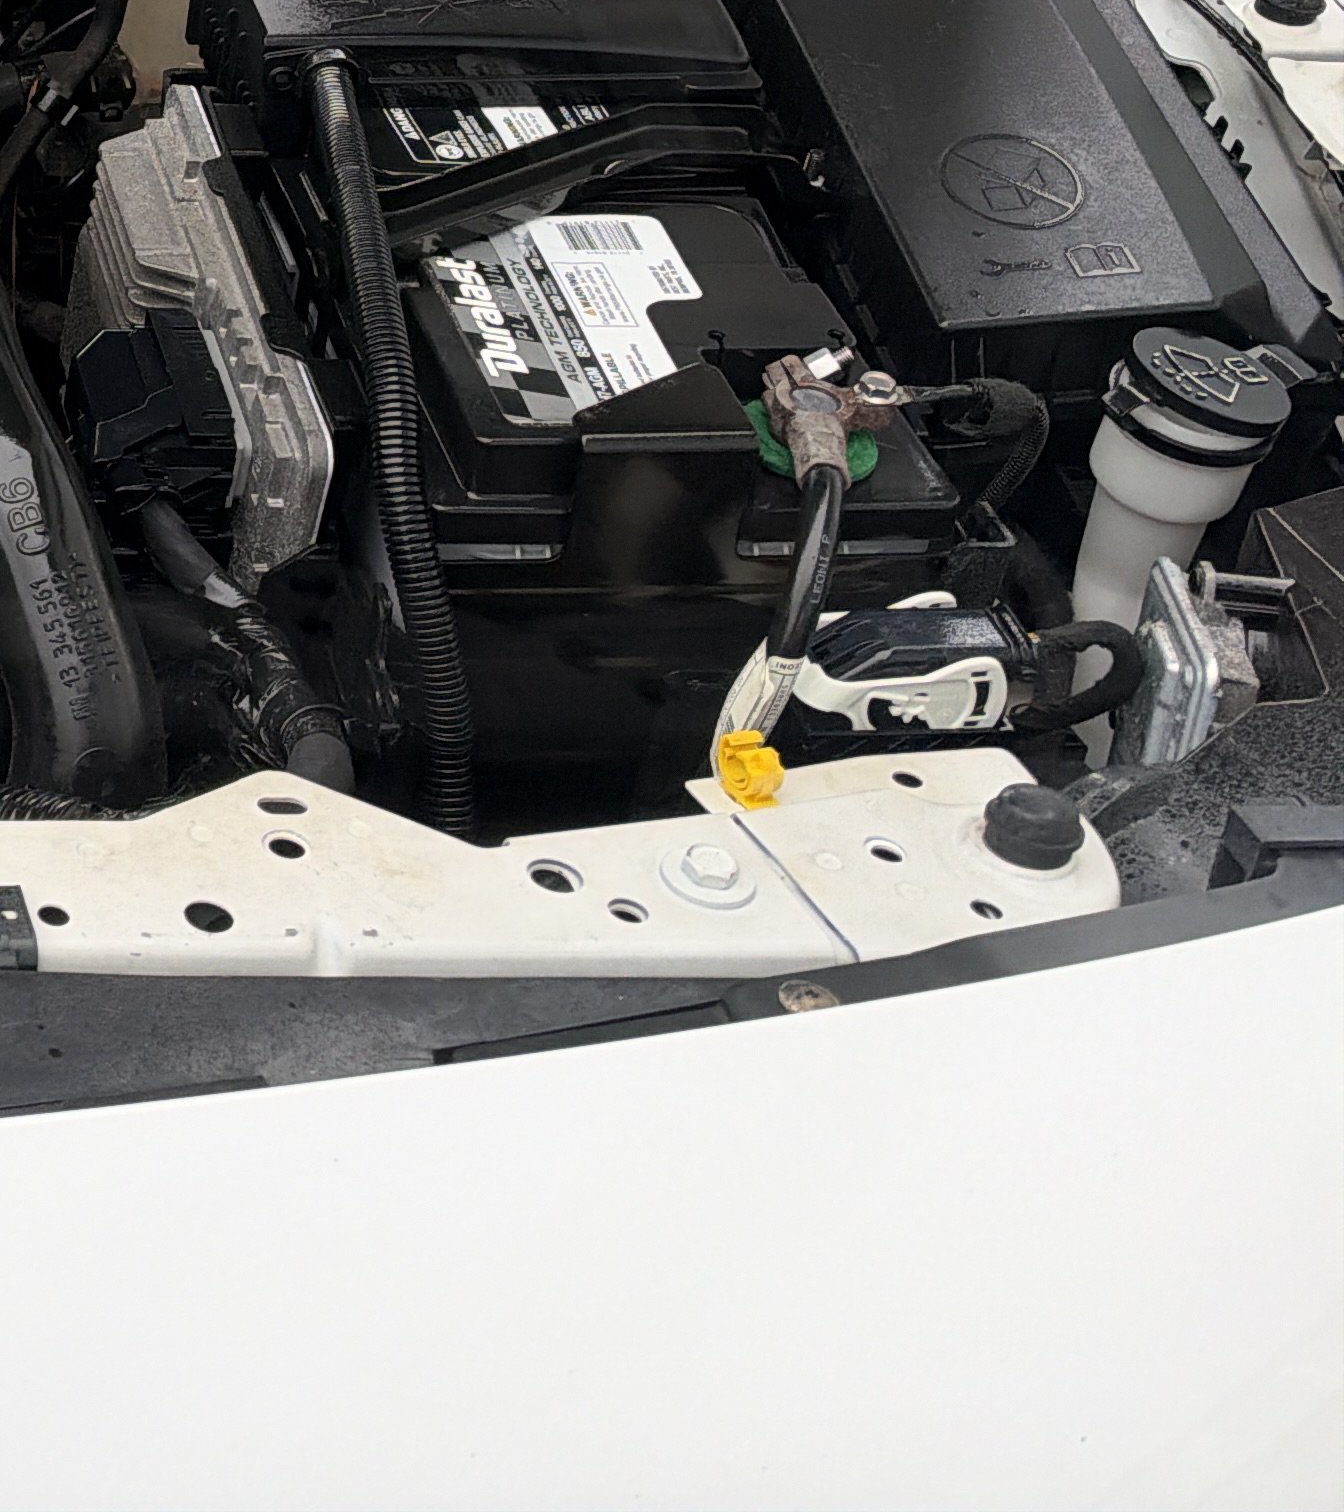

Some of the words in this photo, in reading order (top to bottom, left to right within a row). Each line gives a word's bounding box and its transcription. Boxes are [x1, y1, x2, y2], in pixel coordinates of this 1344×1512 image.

[436, 256, 529, 377] Duralast
[479, 261, 535, 342] PLATINUM
[506, 257, 563, 347] TECHNOLOGY
[554, 350, 583, 384] AGM
[570, 338, 592, 358] 850
[601, 353, 628, 392] PILLABLE
[29, 576, 58, 614] 561
[808, 555, 830, 604] LEONI
[42, 617, 72, 658] 345
[58, 666, 81, 687] 13
